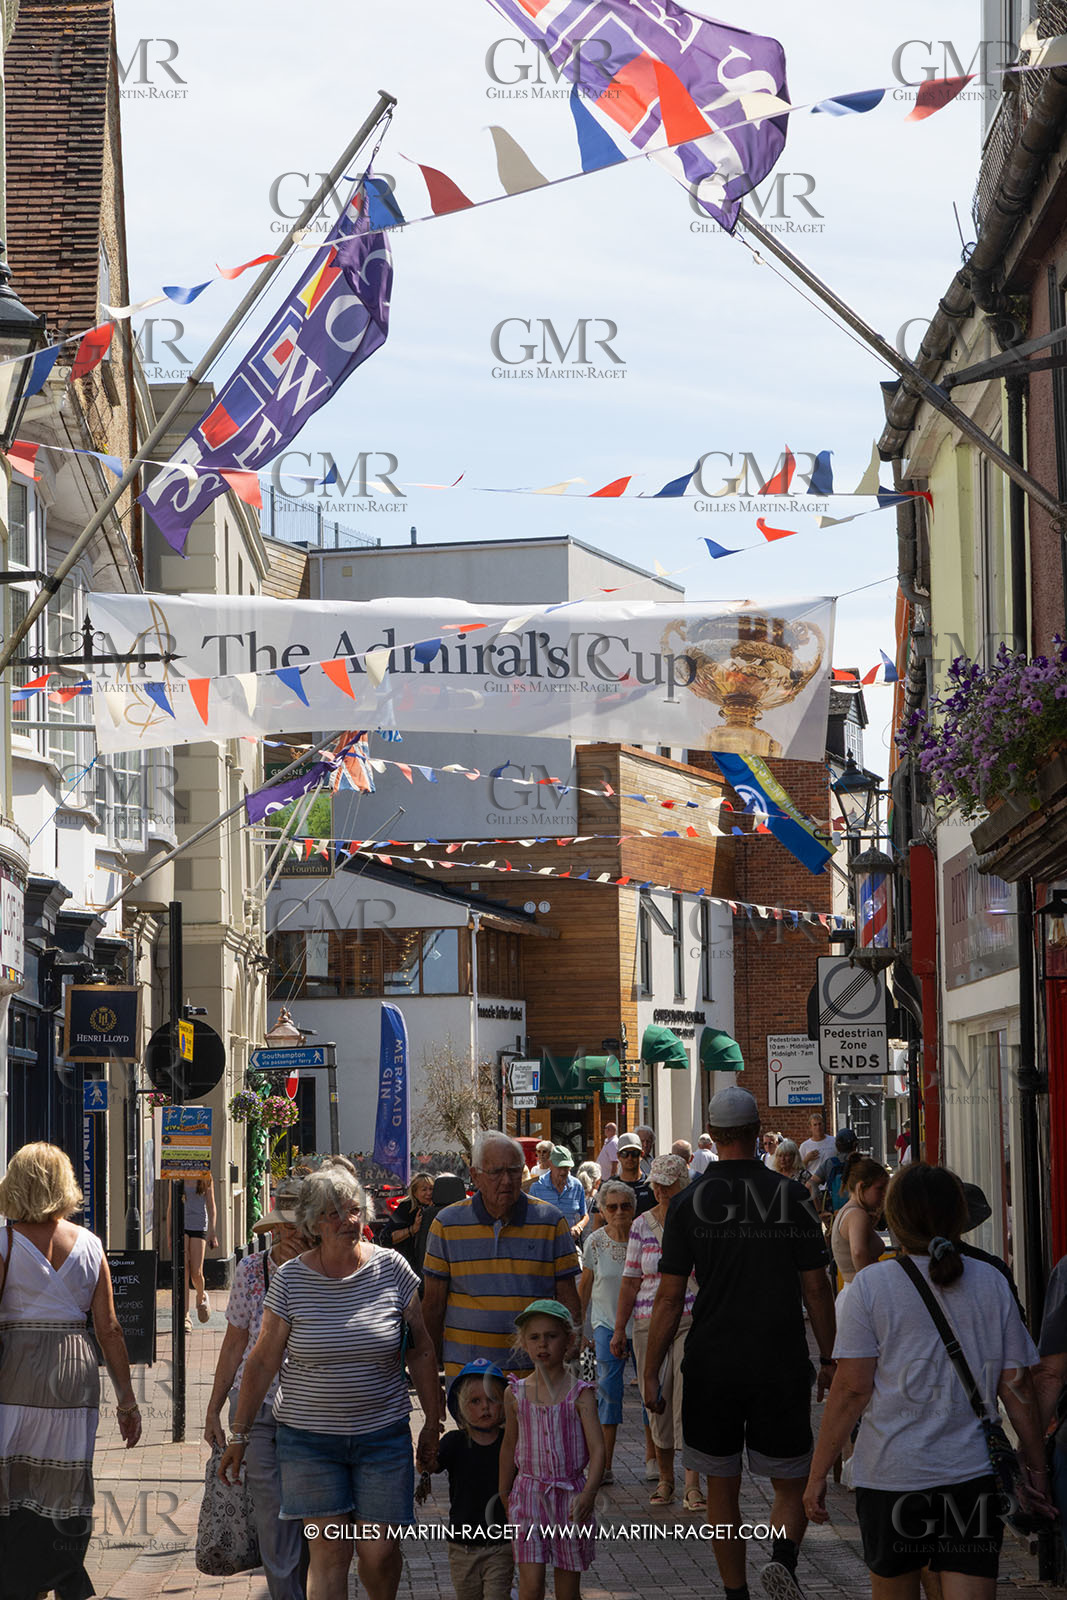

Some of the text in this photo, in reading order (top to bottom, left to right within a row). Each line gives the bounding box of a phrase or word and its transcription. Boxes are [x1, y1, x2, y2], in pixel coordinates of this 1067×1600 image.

[201, 629, 311, 679] The
[586, 635, 697, 703] Cup
[292, 865, 329, 873] Fountain
[77, 1033, 129, 1043] HENRI LLOYD
[824, 1029, 883, 1038] Pedestrian
[840, 1041, 867, 1050] Zone
[262, 1052, 306, 1060] Southampton
[829, 1054, 880, 1068] ENDS
[380, 1067, 394, 1100] GIN
[392, 1038, 404, 1127] MERMAID
